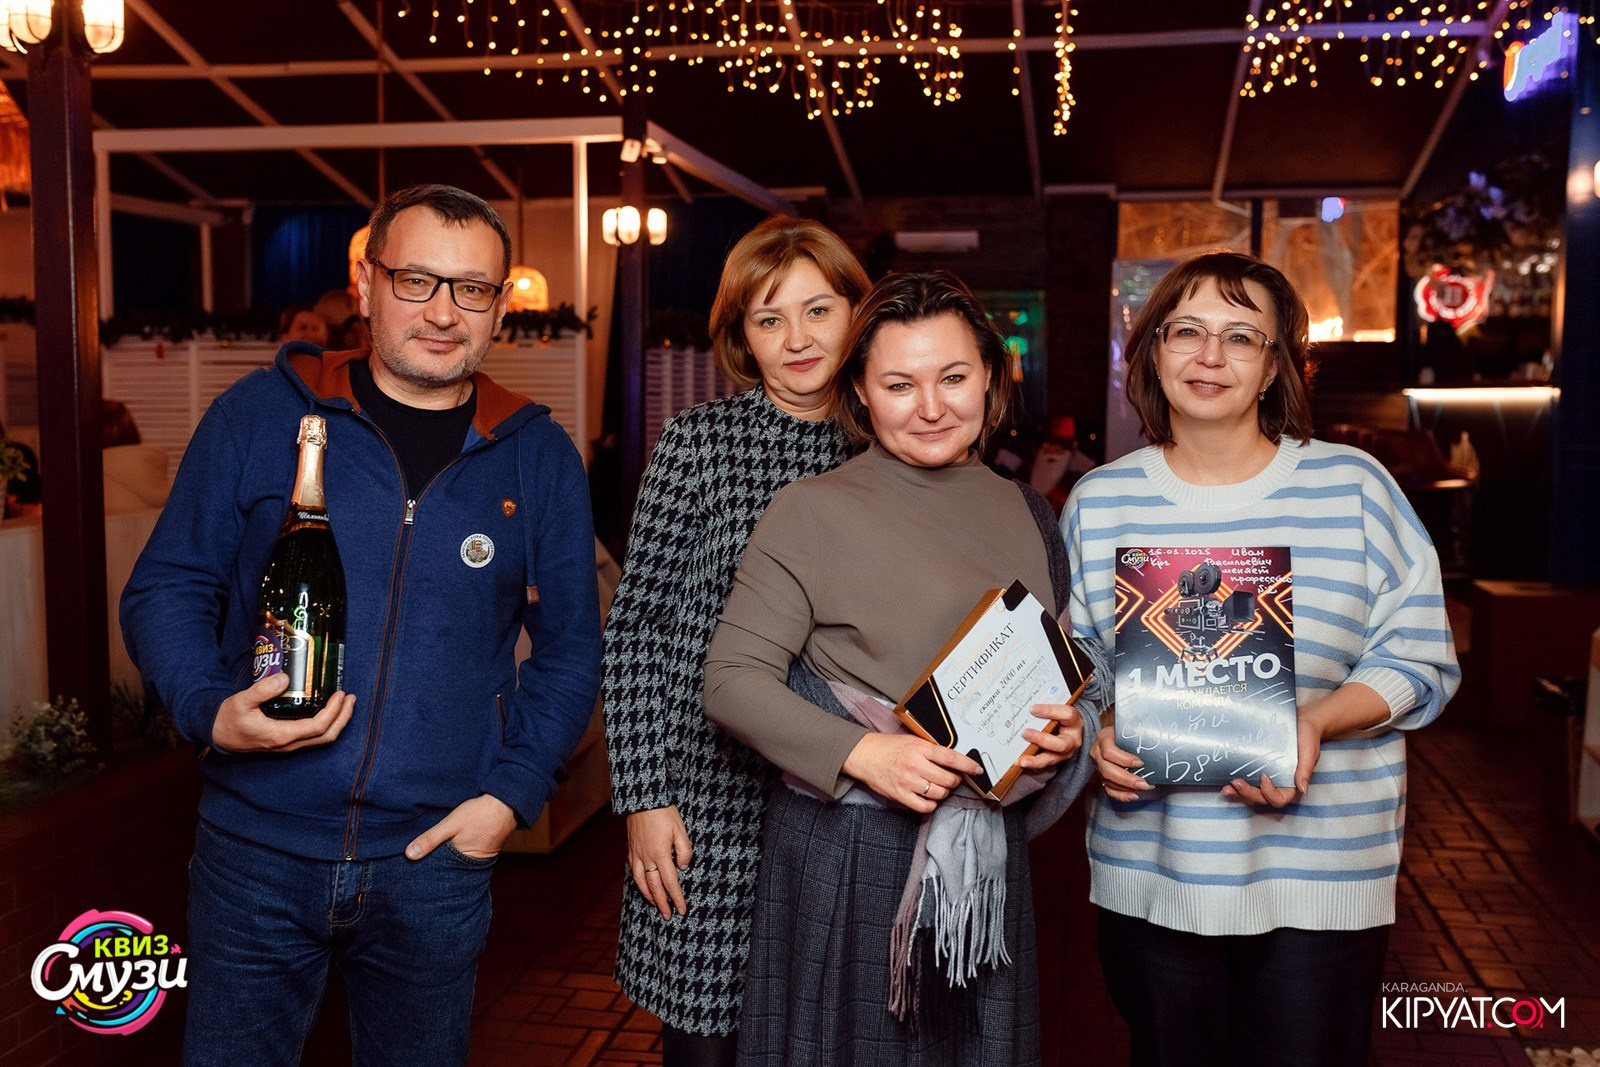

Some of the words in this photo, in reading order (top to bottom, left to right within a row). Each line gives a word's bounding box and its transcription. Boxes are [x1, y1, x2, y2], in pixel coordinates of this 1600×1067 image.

[1149, 548, 1212, 556] 16.01.2025
[1231, 548, 1265, 557] Иван
[1121, 553, 1149, 566] Смузи
[1204, 557, 1272, 567] Васильевич
[1221, 566, 1270, 575] меняет
[947, 622, 1016, 701] СЕРТИФИКАТ
[1128, 668, 1144, 693] 1
[1155, 653, 1282, 689] МЕСТО
[979, 689, 1001, 714] скидка
[999, 669, 1017, 689] 2000
[1161, 683, 1248, 701] НАГРАЖДАЕТСЯ
[1176, 696, 1233, 711] КОМАНДА
